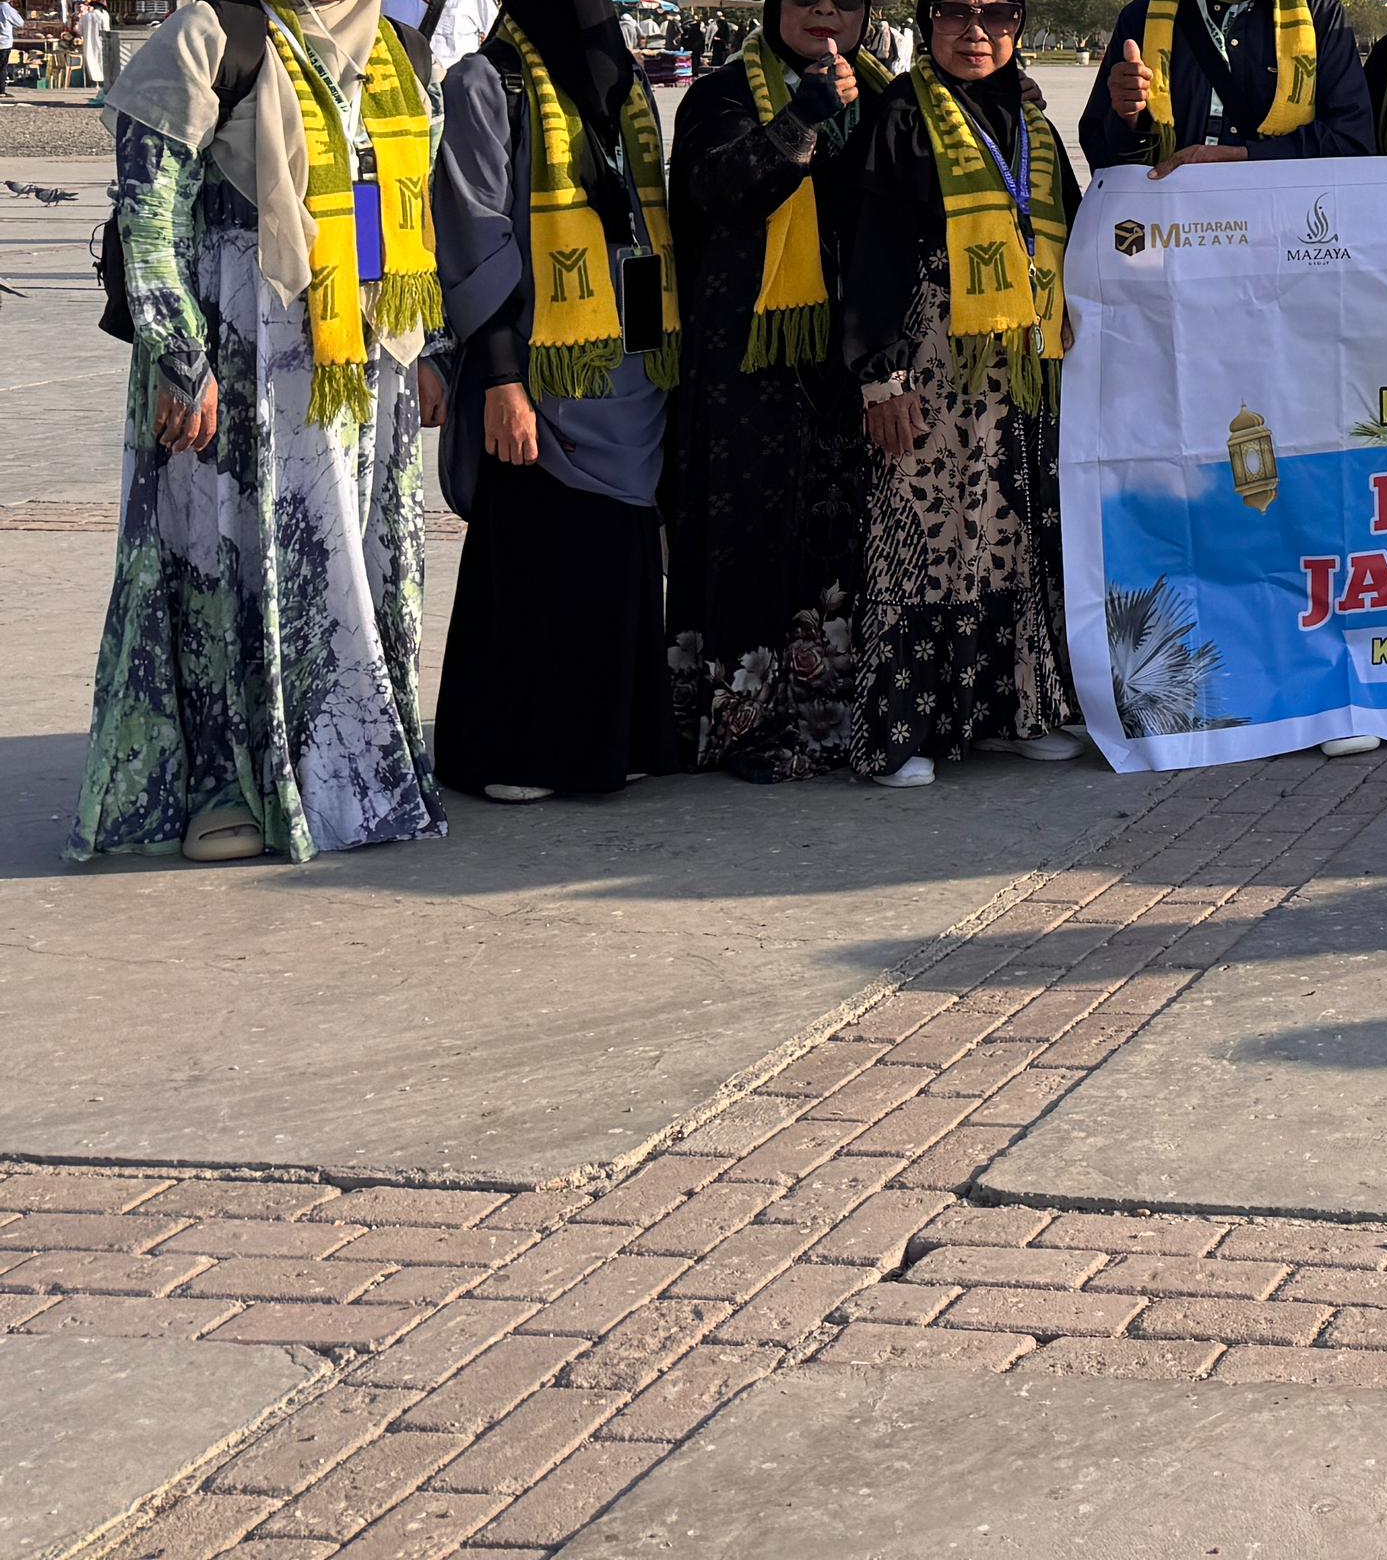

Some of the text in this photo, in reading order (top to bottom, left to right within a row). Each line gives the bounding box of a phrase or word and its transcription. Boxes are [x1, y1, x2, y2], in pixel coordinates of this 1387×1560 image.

[549, 247, 595, 303] M
[964, 241, 1014, 296] M
[1287, 248, 1351, 262] MAZAYA
